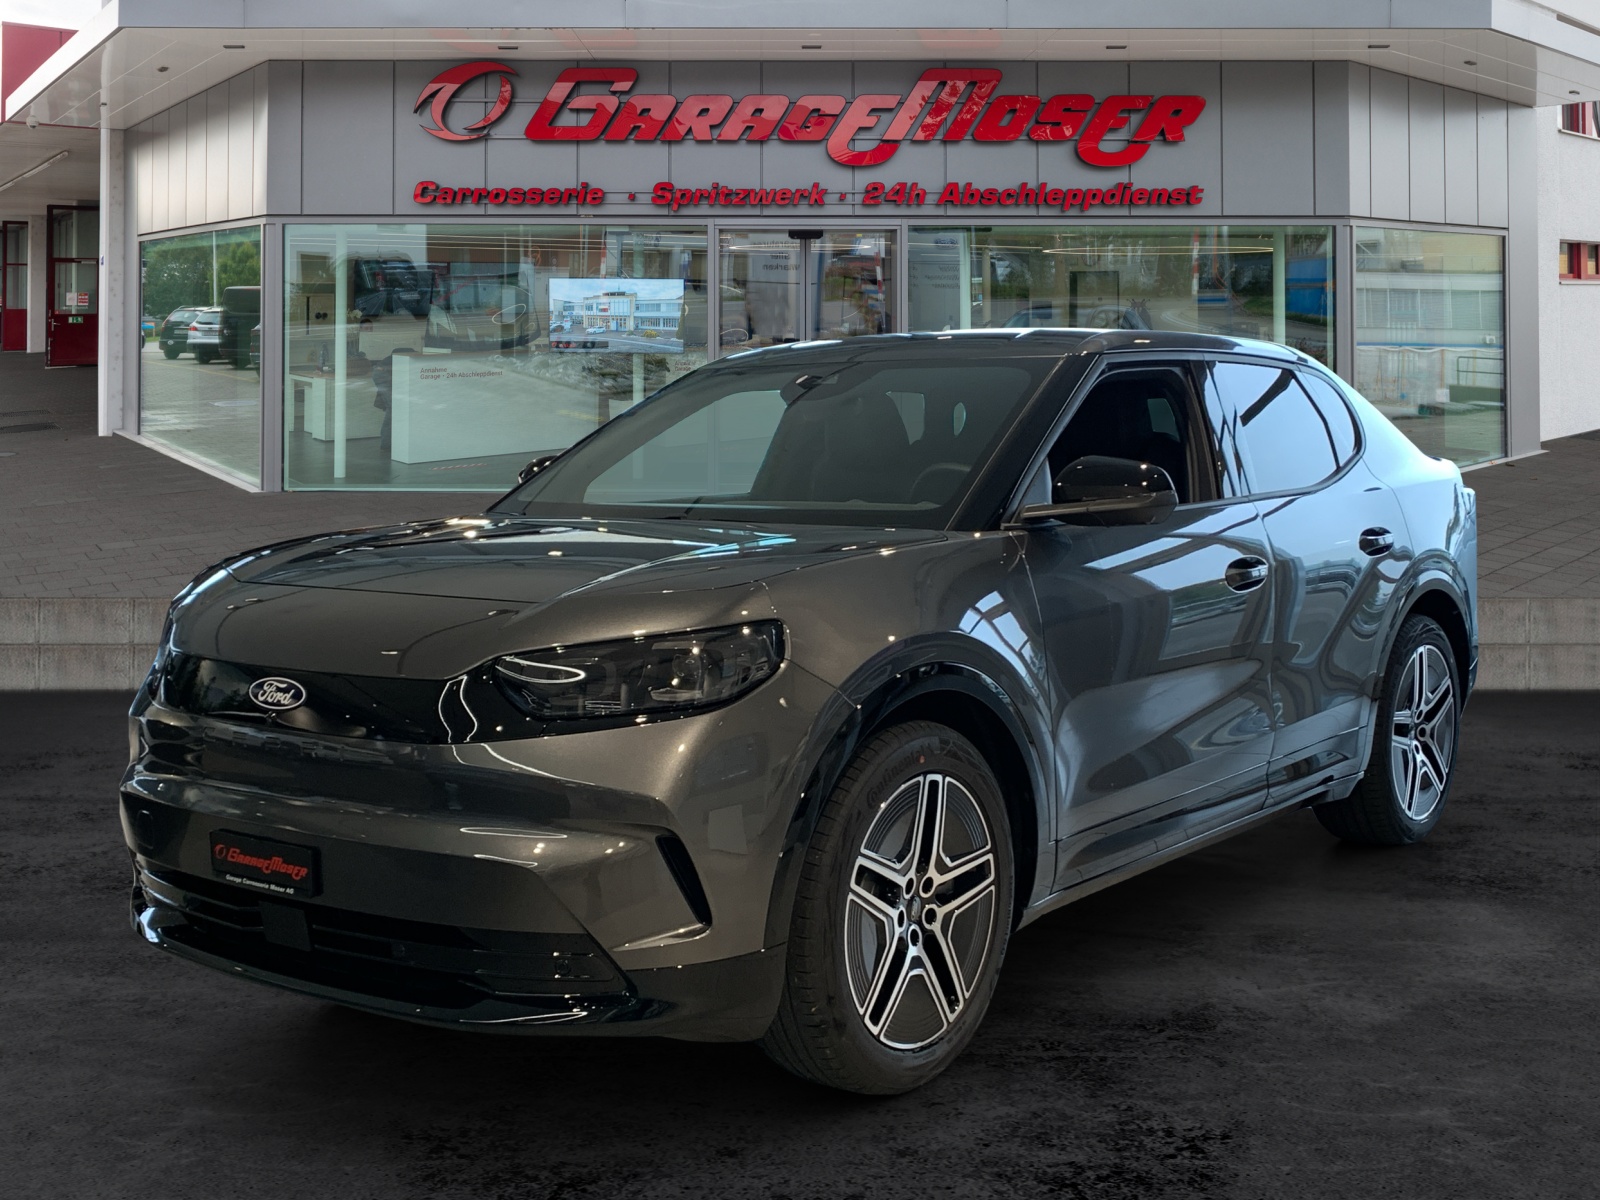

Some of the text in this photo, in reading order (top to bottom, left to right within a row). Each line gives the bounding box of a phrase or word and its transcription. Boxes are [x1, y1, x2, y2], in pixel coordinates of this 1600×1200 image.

[413, 181, 1204, 211] Carrosserie Spritzwerk 24h Abschleppdienst
[257, 680, 295, 705] Ford
[226, 874, 242, 883] Garage
[270, 884, 286, 893] Moser
